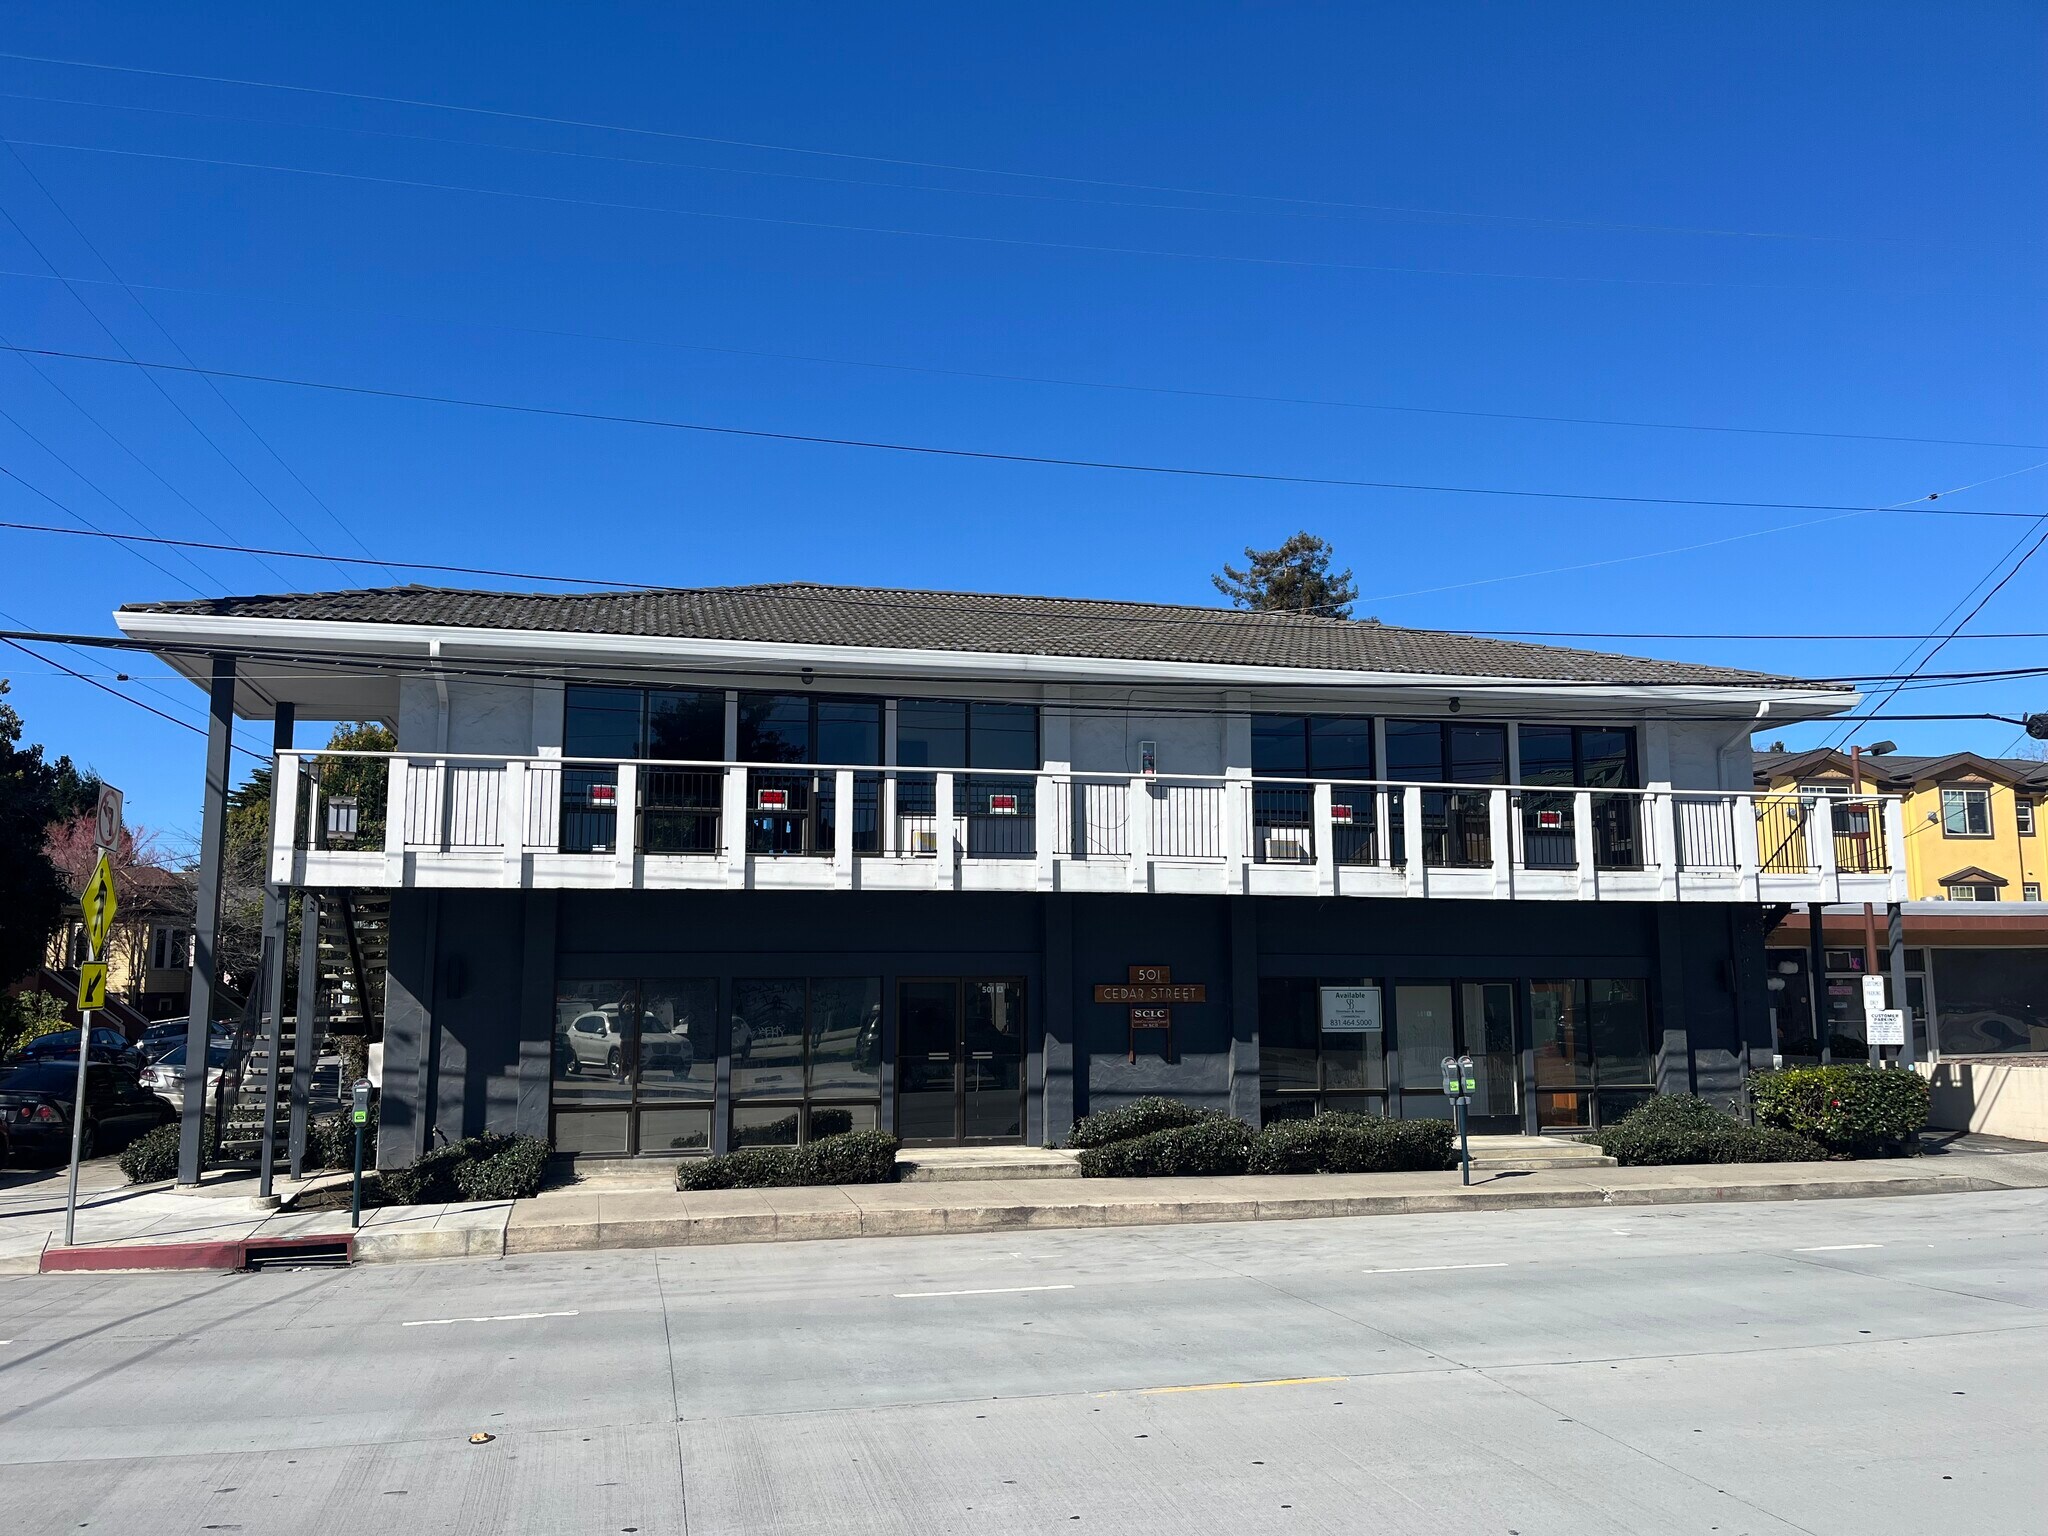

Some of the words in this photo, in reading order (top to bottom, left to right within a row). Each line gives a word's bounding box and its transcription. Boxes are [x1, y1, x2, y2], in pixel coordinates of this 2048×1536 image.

[1138, 969, 1160, 981] 501
[1103, 988, 1144, 999] CEDAR
[1150, 988, 1196, 999] STREET
[1134, 1010, 1166, 1018] SCLC
